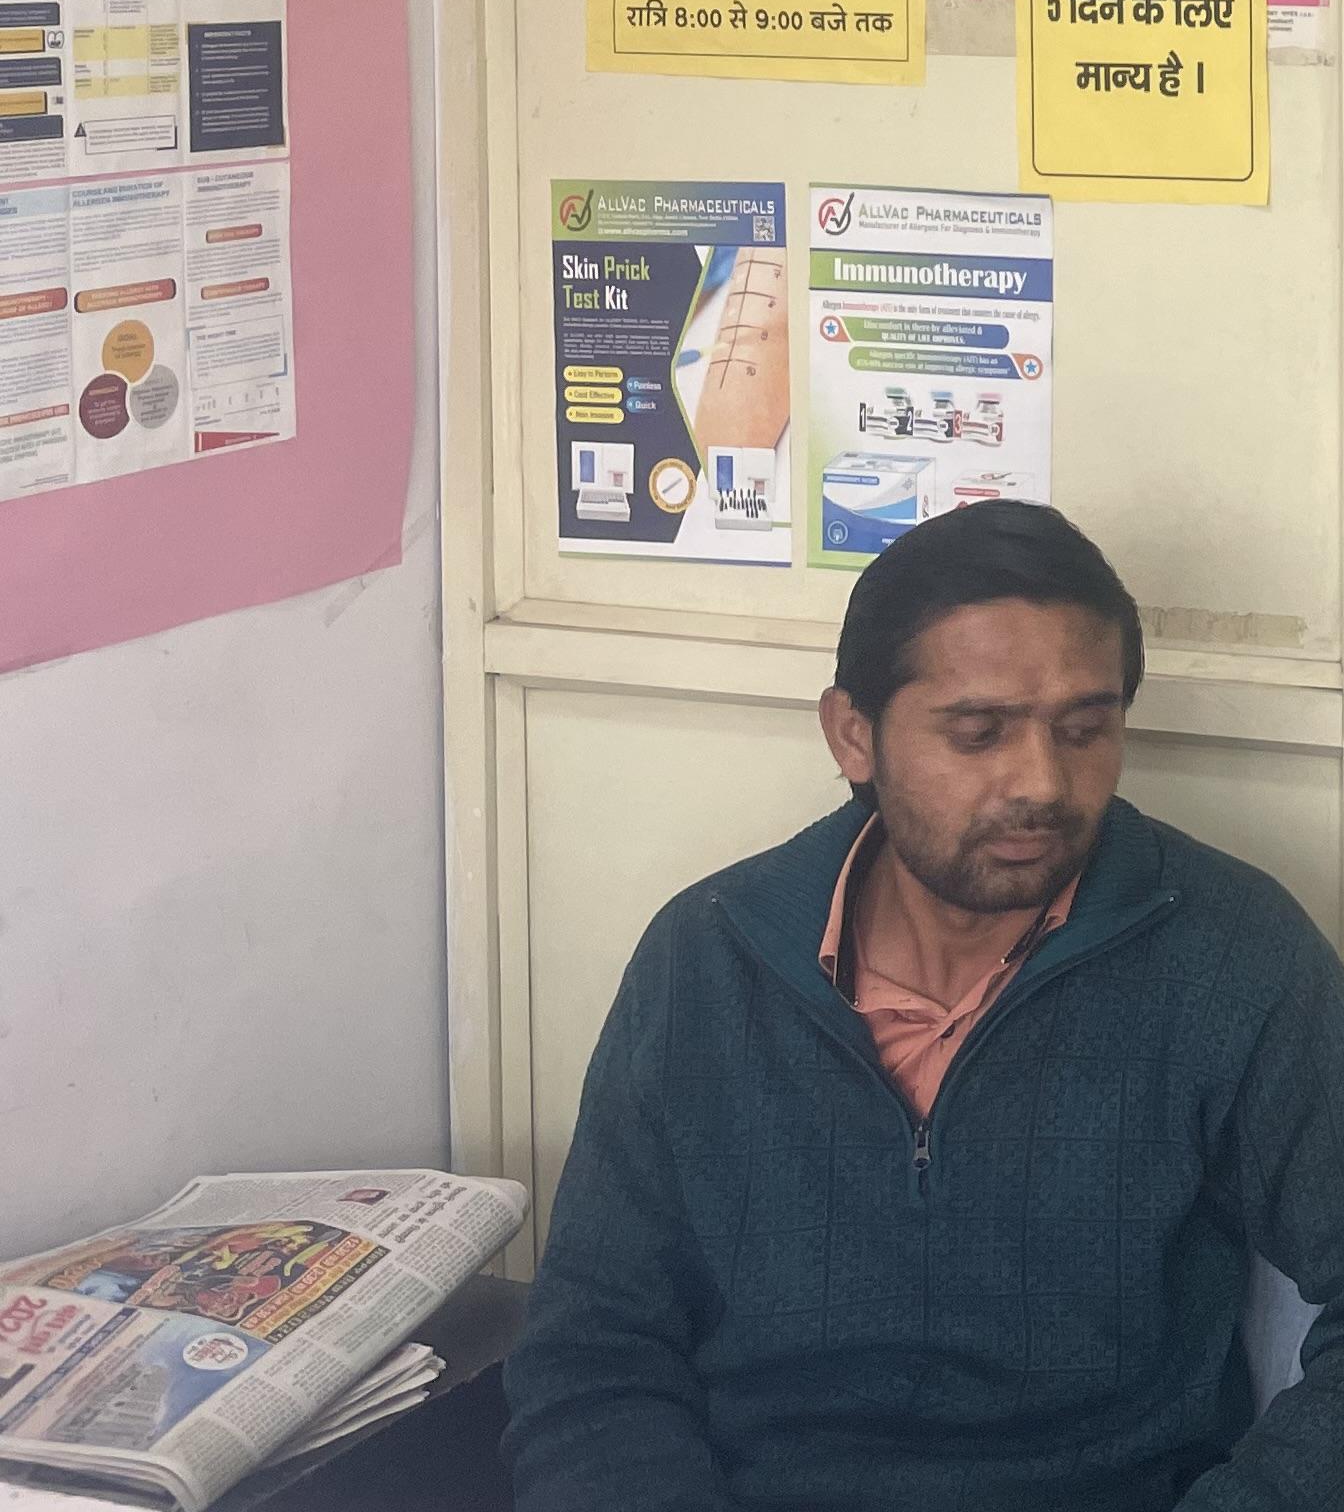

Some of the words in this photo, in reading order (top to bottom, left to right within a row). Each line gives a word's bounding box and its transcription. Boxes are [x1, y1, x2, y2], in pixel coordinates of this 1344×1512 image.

[627, 0, 667, 26] रात्रि
[676, 8, 721, 28] 8:00
[729, 0, 747, 29] से
[756, 9, 802, 30] 9:00
[810, 3, 847, 31] बजे
[854, 13, 893, 32] तक
[1076, 62, 1152, 91] मान्य
[655, 196, 774, 214] PHARMACEUTICALS
[916, 206, 1041, 226] PHARMACEUTICALS
[563, 255, 598, 279] Skin
[605, 256, 649, 280] Prick
[834, 258, 1026, 294] Immunotherapy
[563, 285, 599, 309] Test
[606, 286, 628, 309] Kit
[635, 401, 656, 410] Quick
